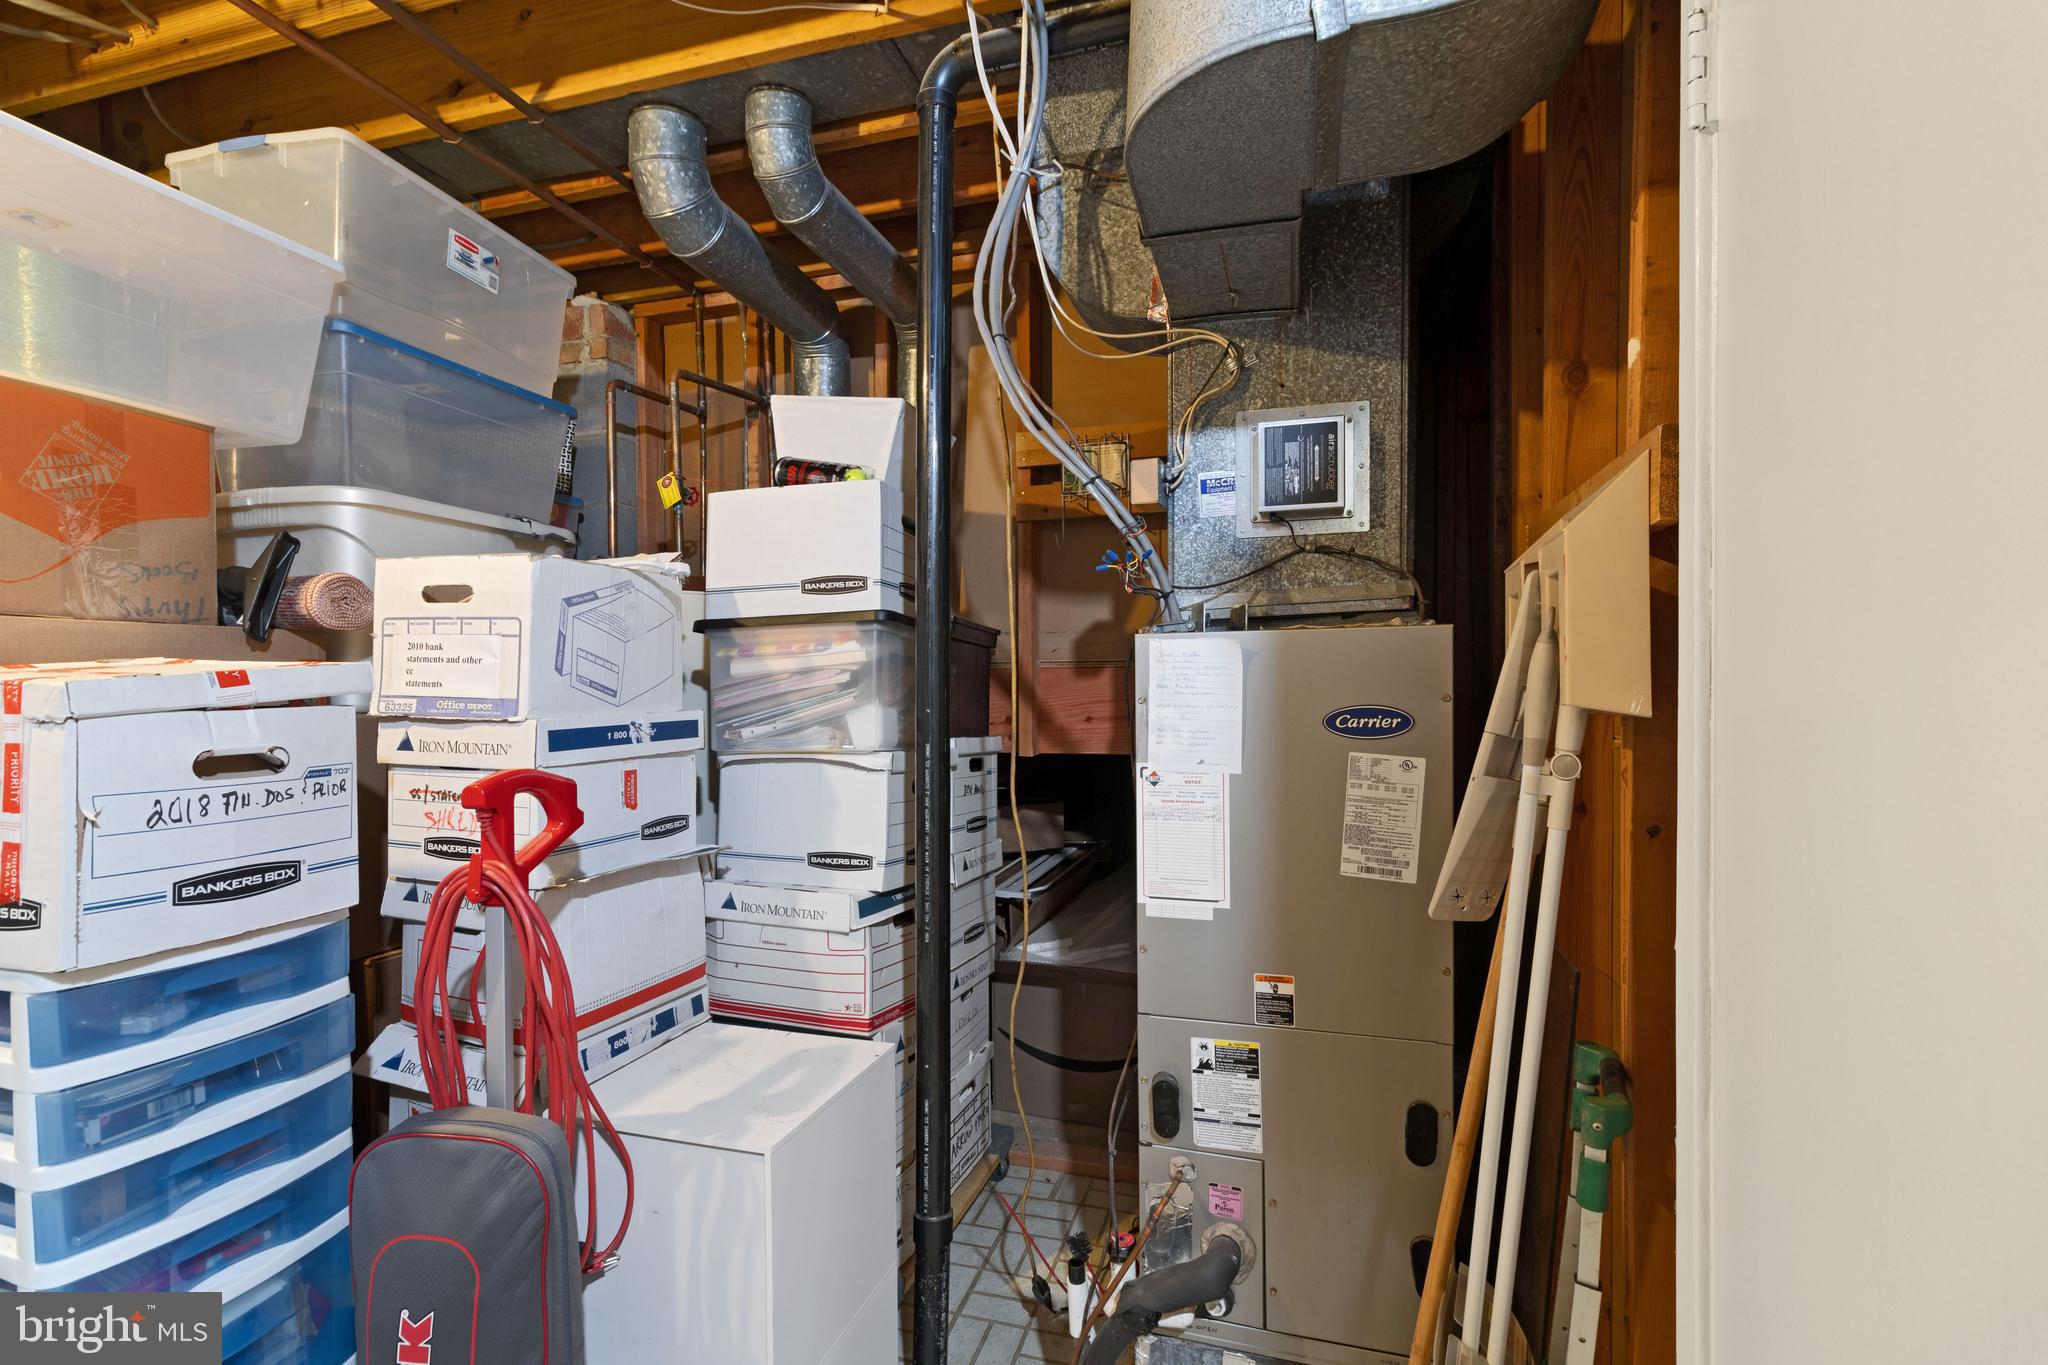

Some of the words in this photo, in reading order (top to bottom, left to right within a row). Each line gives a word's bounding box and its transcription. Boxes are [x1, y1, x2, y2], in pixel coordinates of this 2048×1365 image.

[1206, 478, 1234, 488] McCR
[804, 580, 844, 591] BANKERS
[845, 578, 866, 589] BOX
[407, 642, 424, 651] 2010
[425, 642, 444, 651] bank
[406, 655, 444, 663] statements
[446, 656, 460, 664] and
[461, 656, 483, 665] other
[405, 680, 443, 688] statements
[384, 702, 413, 712] 63325
[436, 700, 466, 709] Office
[1335, 714, 1402, 729] Carrier
[607, 731, 612, 740] 1
[613, 730, 628, 740] 800
[418, 738, 446, 753] IRON
[447, 739, 509, 756] MOUNTAIN
[10, 751, 19, 804] PRIORITY
[146, 793, 211, 829] 2018
[312, 778, 347, 800] PRIOR
[644, 822, 674, 837] BANKERS
[673, 819, 690, 831] BOX
[427, 843, 468, 853] BANKERS
[810, 856, 850, 866] BANKERS
[850, 858, 870, 867] BOX
[181, 873, 262, 898] BANKERS
[264, 867, 296, 882] BOX
[10, 908, 36, 921] BOX
[740, 900, 766, 916] IRON
[766, 902, 826, 921] MOUNTAIN
[613, 1036, 628, 1049] 800
[1215, 1203, 1234, 1213] Puron
[1195, 1325, 1218, 1333] OPEN
